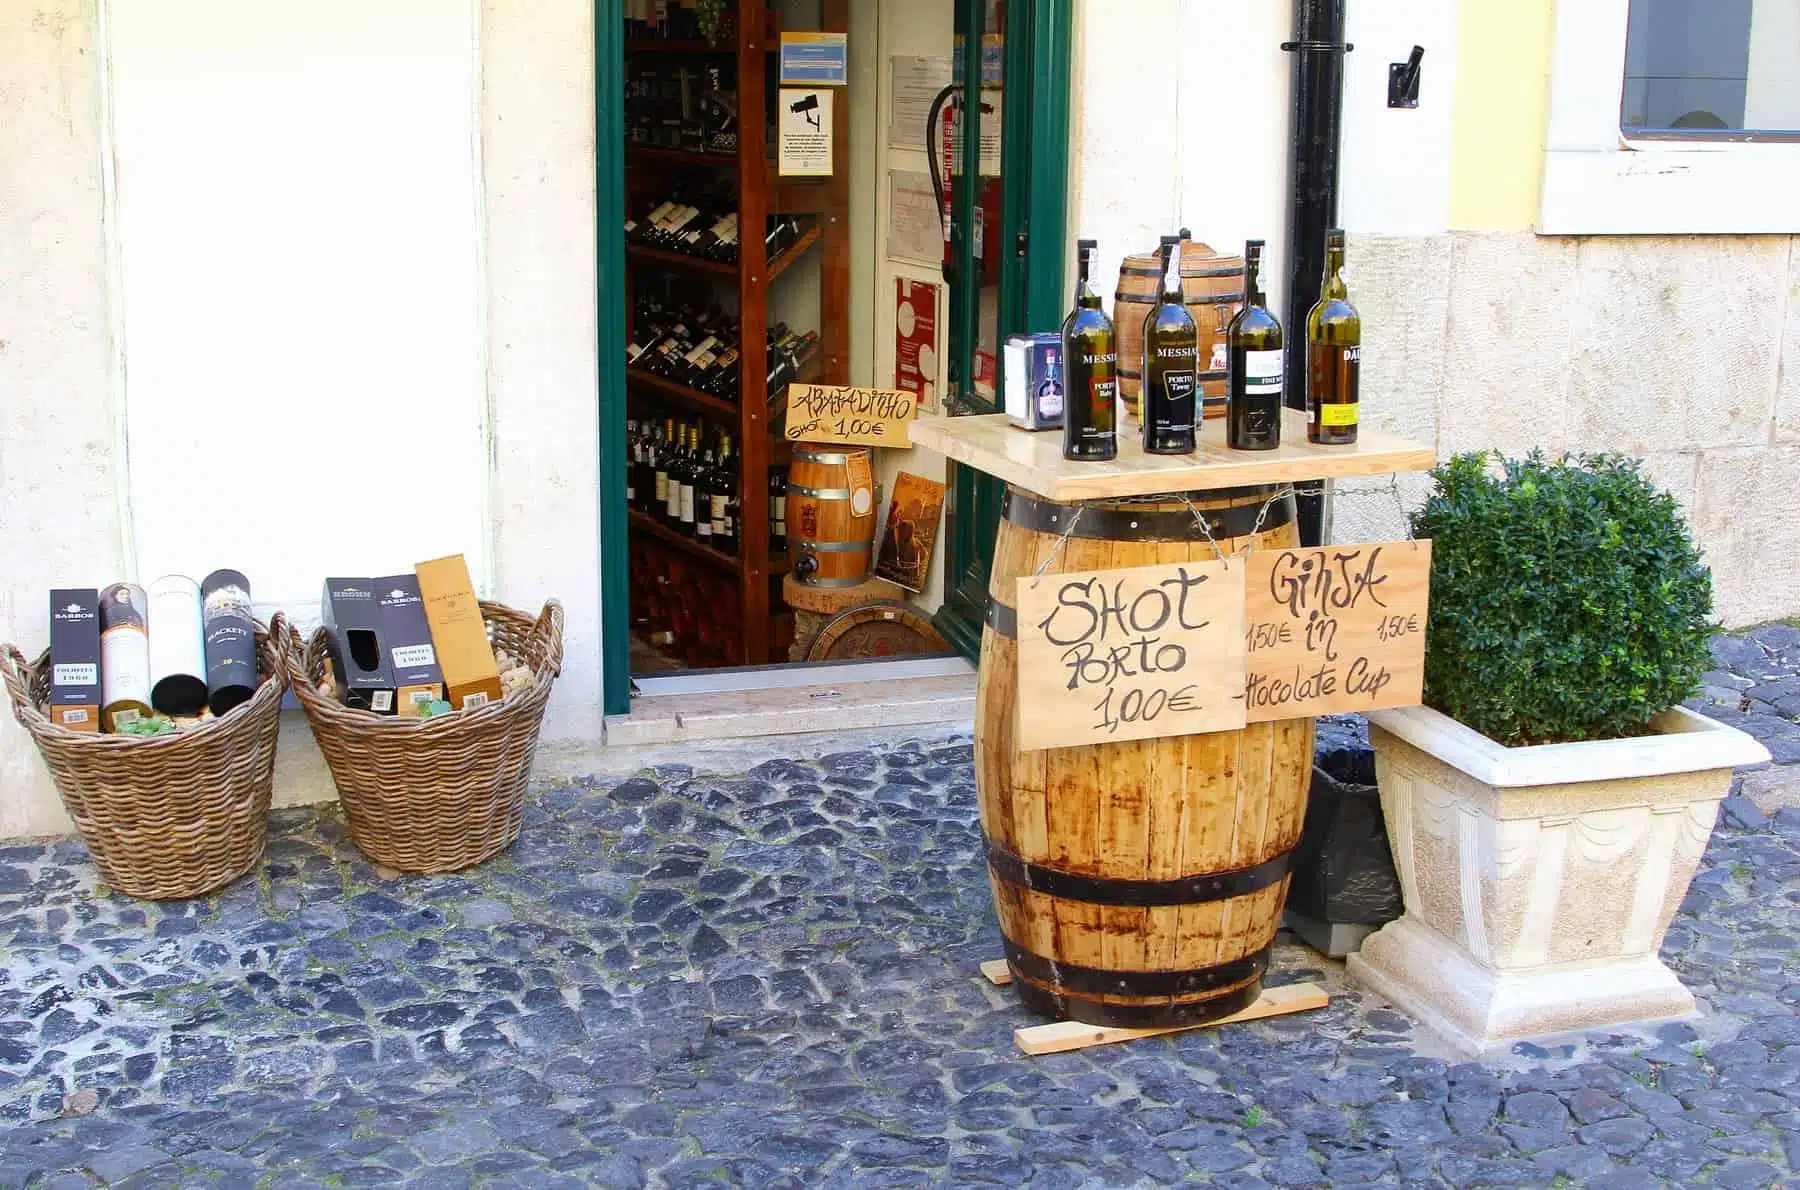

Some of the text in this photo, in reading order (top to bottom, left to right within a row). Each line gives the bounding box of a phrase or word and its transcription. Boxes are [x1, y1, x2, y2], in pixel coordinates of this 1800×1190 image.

[787, 417, 885, 439] SHOT 1,00€
[1038, 567, 1209, 646] SHOT
[1377, 614, 1419, 642] 1,50€
[1060, 635, 1187, 690] PORTO
[1345, 656, 1391, 700] Cup
[1093, 684, 1203, 734] 1,00€
